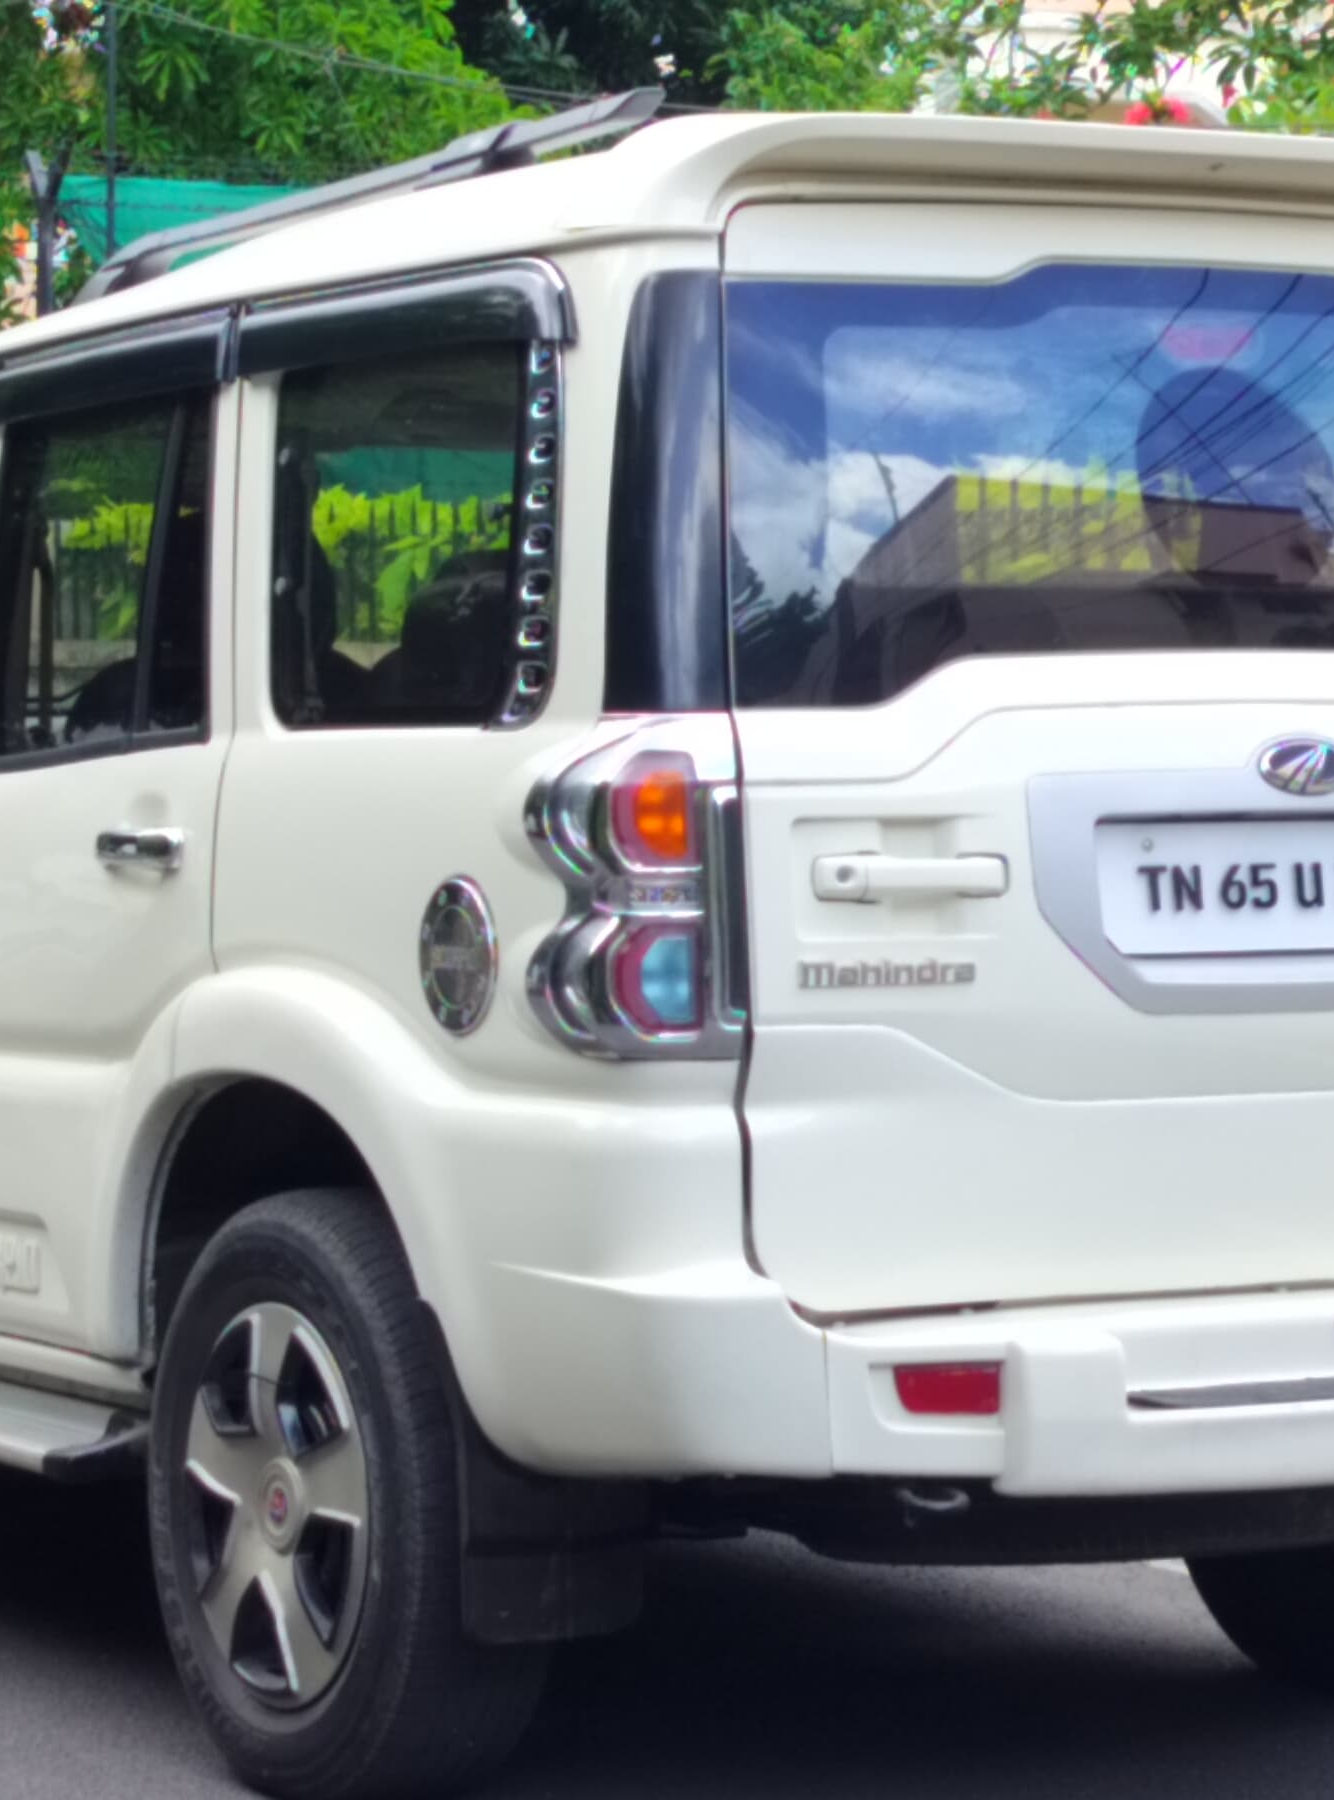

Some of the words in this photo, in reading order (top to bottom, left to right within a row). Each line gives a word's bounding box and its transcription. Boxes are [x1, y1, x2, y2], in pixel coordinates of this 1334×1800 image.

[1137, 864, 1204, 913] TN
[1219, 863, 1279, 910] 65
[1293, 862, 1326, 909] U
[798, 958, 975, 989] Mahindra
